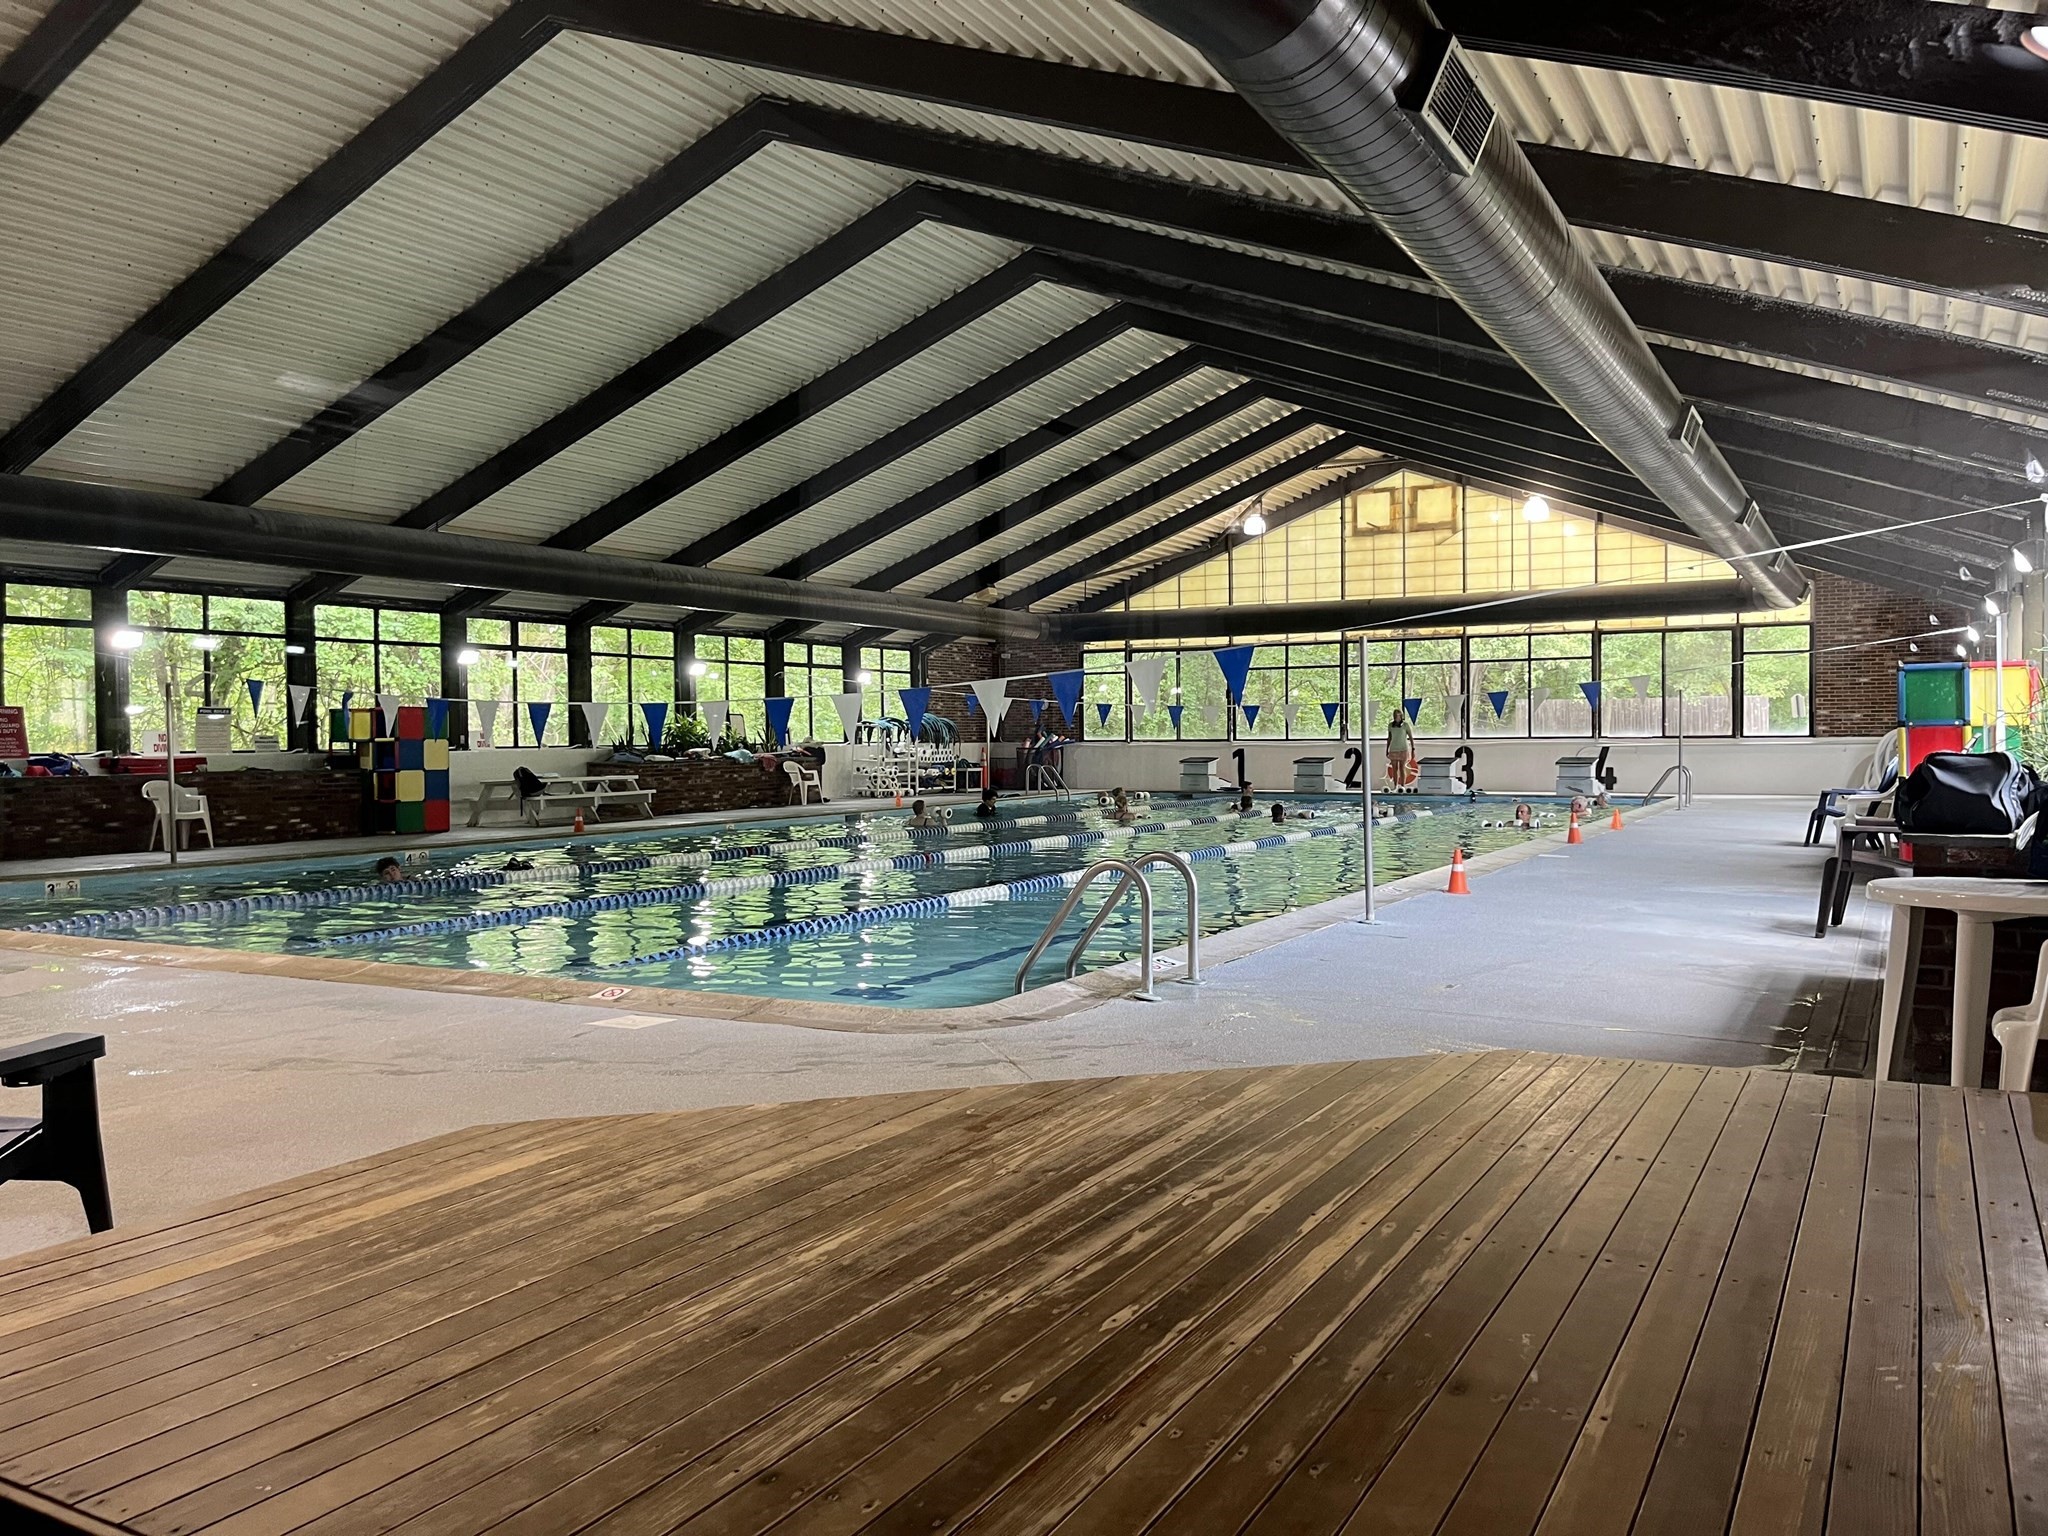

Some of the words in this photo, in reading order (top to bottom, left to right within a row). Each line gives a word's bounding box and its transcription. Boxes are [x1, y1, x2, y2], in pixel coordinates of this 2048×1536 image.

[153, 743, 168, 752] DIVIN
[158, 733, 167, 742] NO
[1232, 748, 1245, 788] 1
[1344, 747, 1362, 788] 2
[1454, 745, 1474, 789] 3
[1595, 746, 1617, 790] 4
